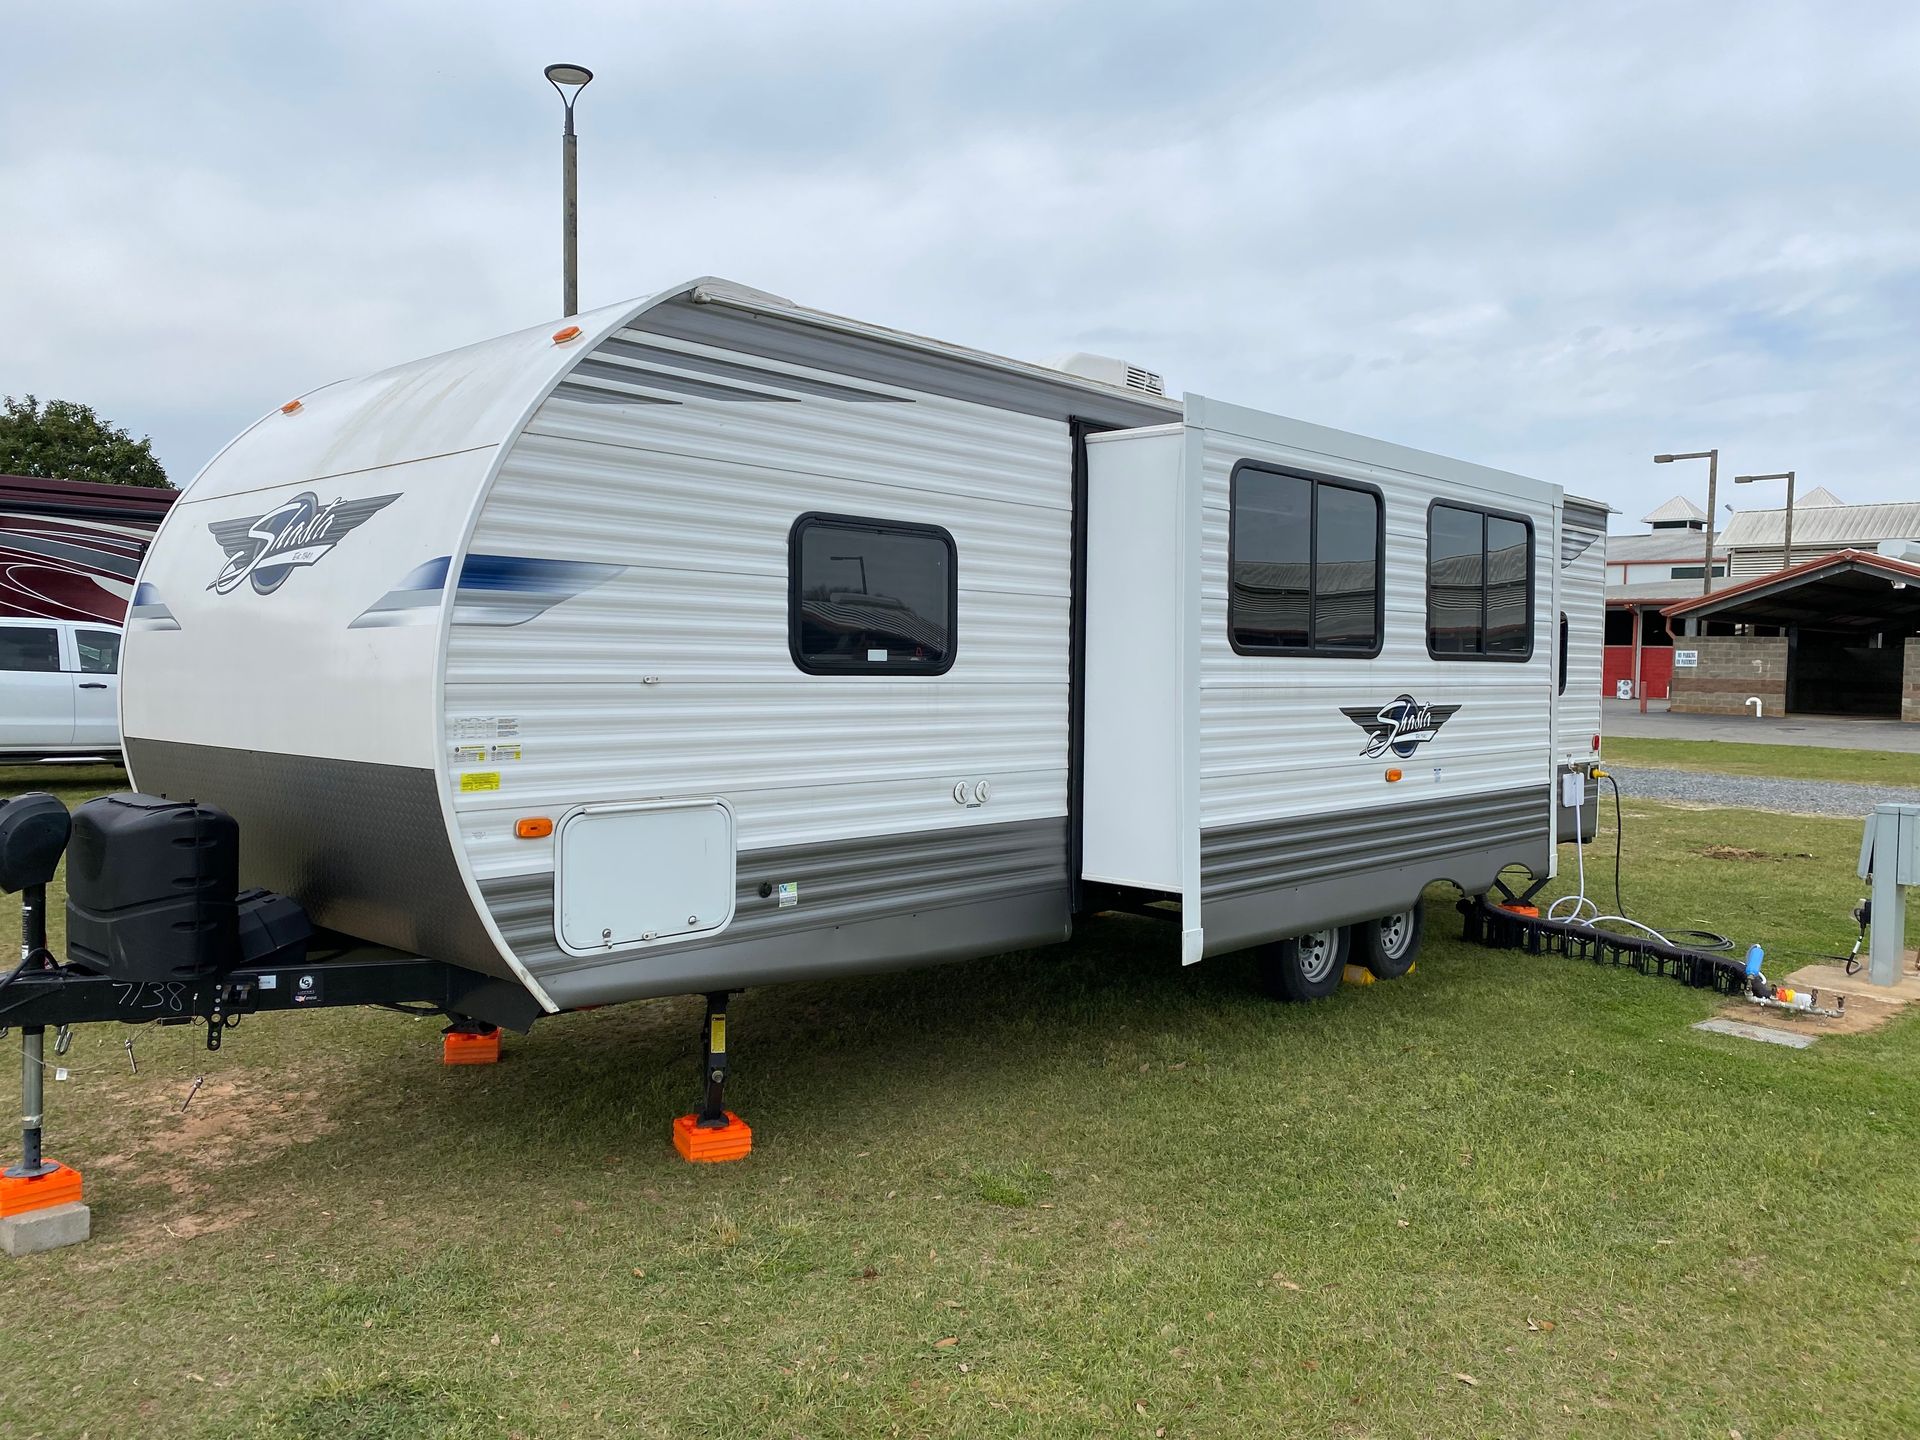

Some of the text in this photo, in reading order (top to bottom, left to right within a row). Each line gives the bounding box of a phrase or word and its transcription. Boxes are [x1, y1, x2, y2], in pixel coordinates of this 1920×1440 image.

[206, 497, 347, 595] Shasta
[1359, 701, 1435, 759] Shasta
[112, 981, 188, 1012] 7138
